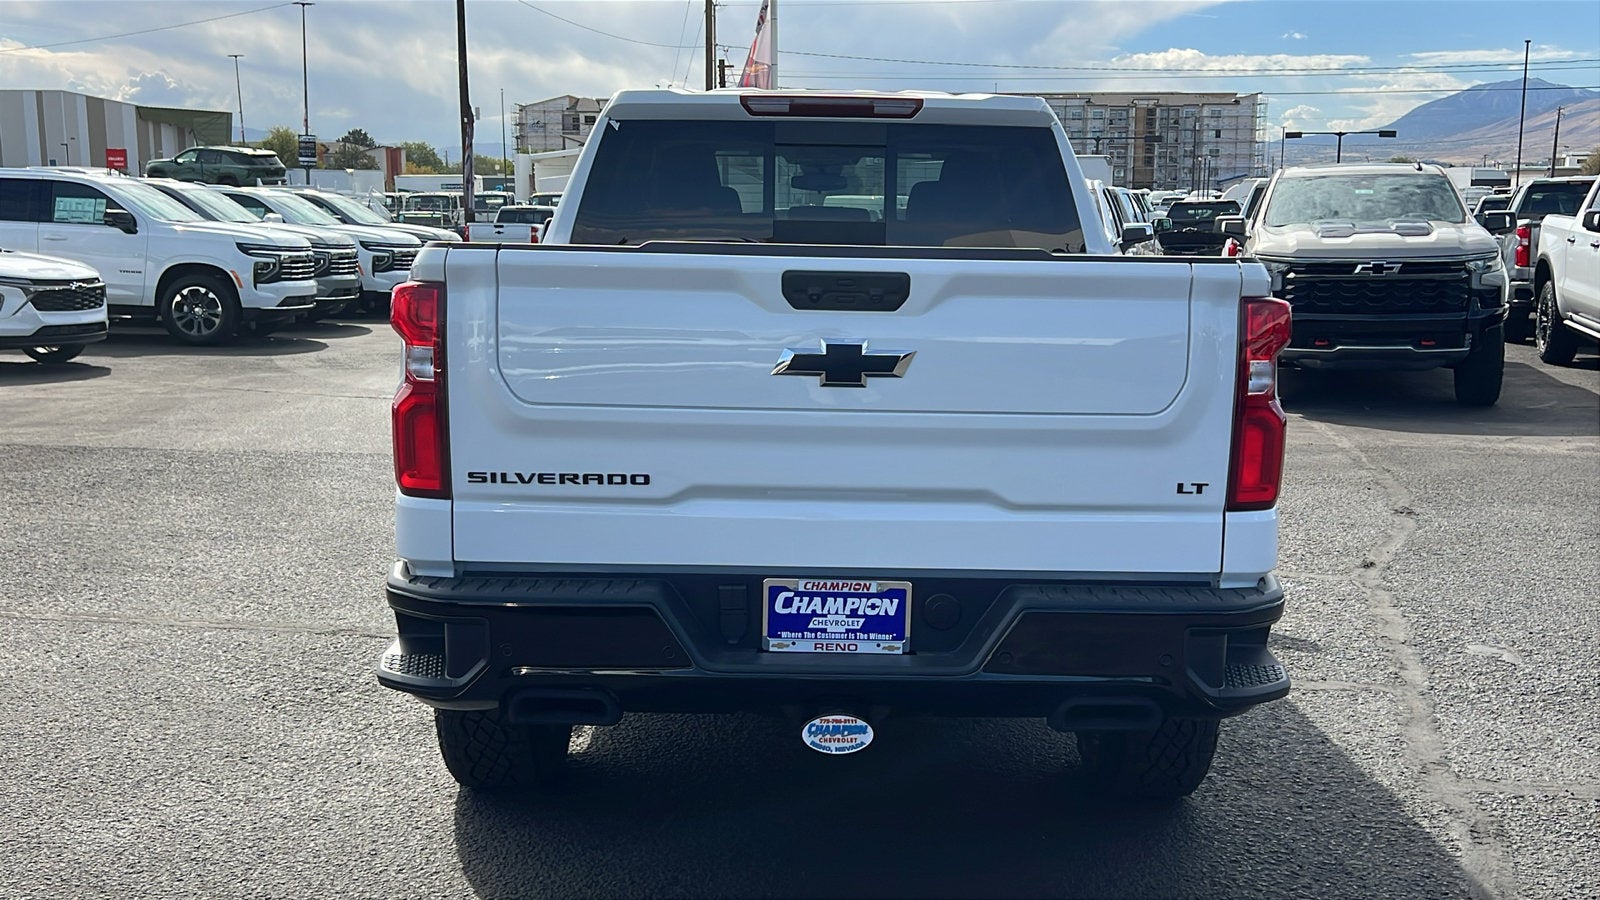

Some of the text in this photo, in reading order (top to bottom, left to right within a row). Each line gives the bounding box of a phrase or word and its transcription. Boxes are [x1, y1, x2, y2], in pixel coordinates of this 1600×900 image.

[467, 472, 651, 486] SILVERADO
[1176, 482, 1209, 495] LT
[803, 581, 872, 592] CHAMPION
[774, 591, 899, 616] CHAMPION
[812, 619, 861, 628] CHEVROLET
[813, 642, 858, 652] RENO
[834, 740, 867, 752] NEVADA
